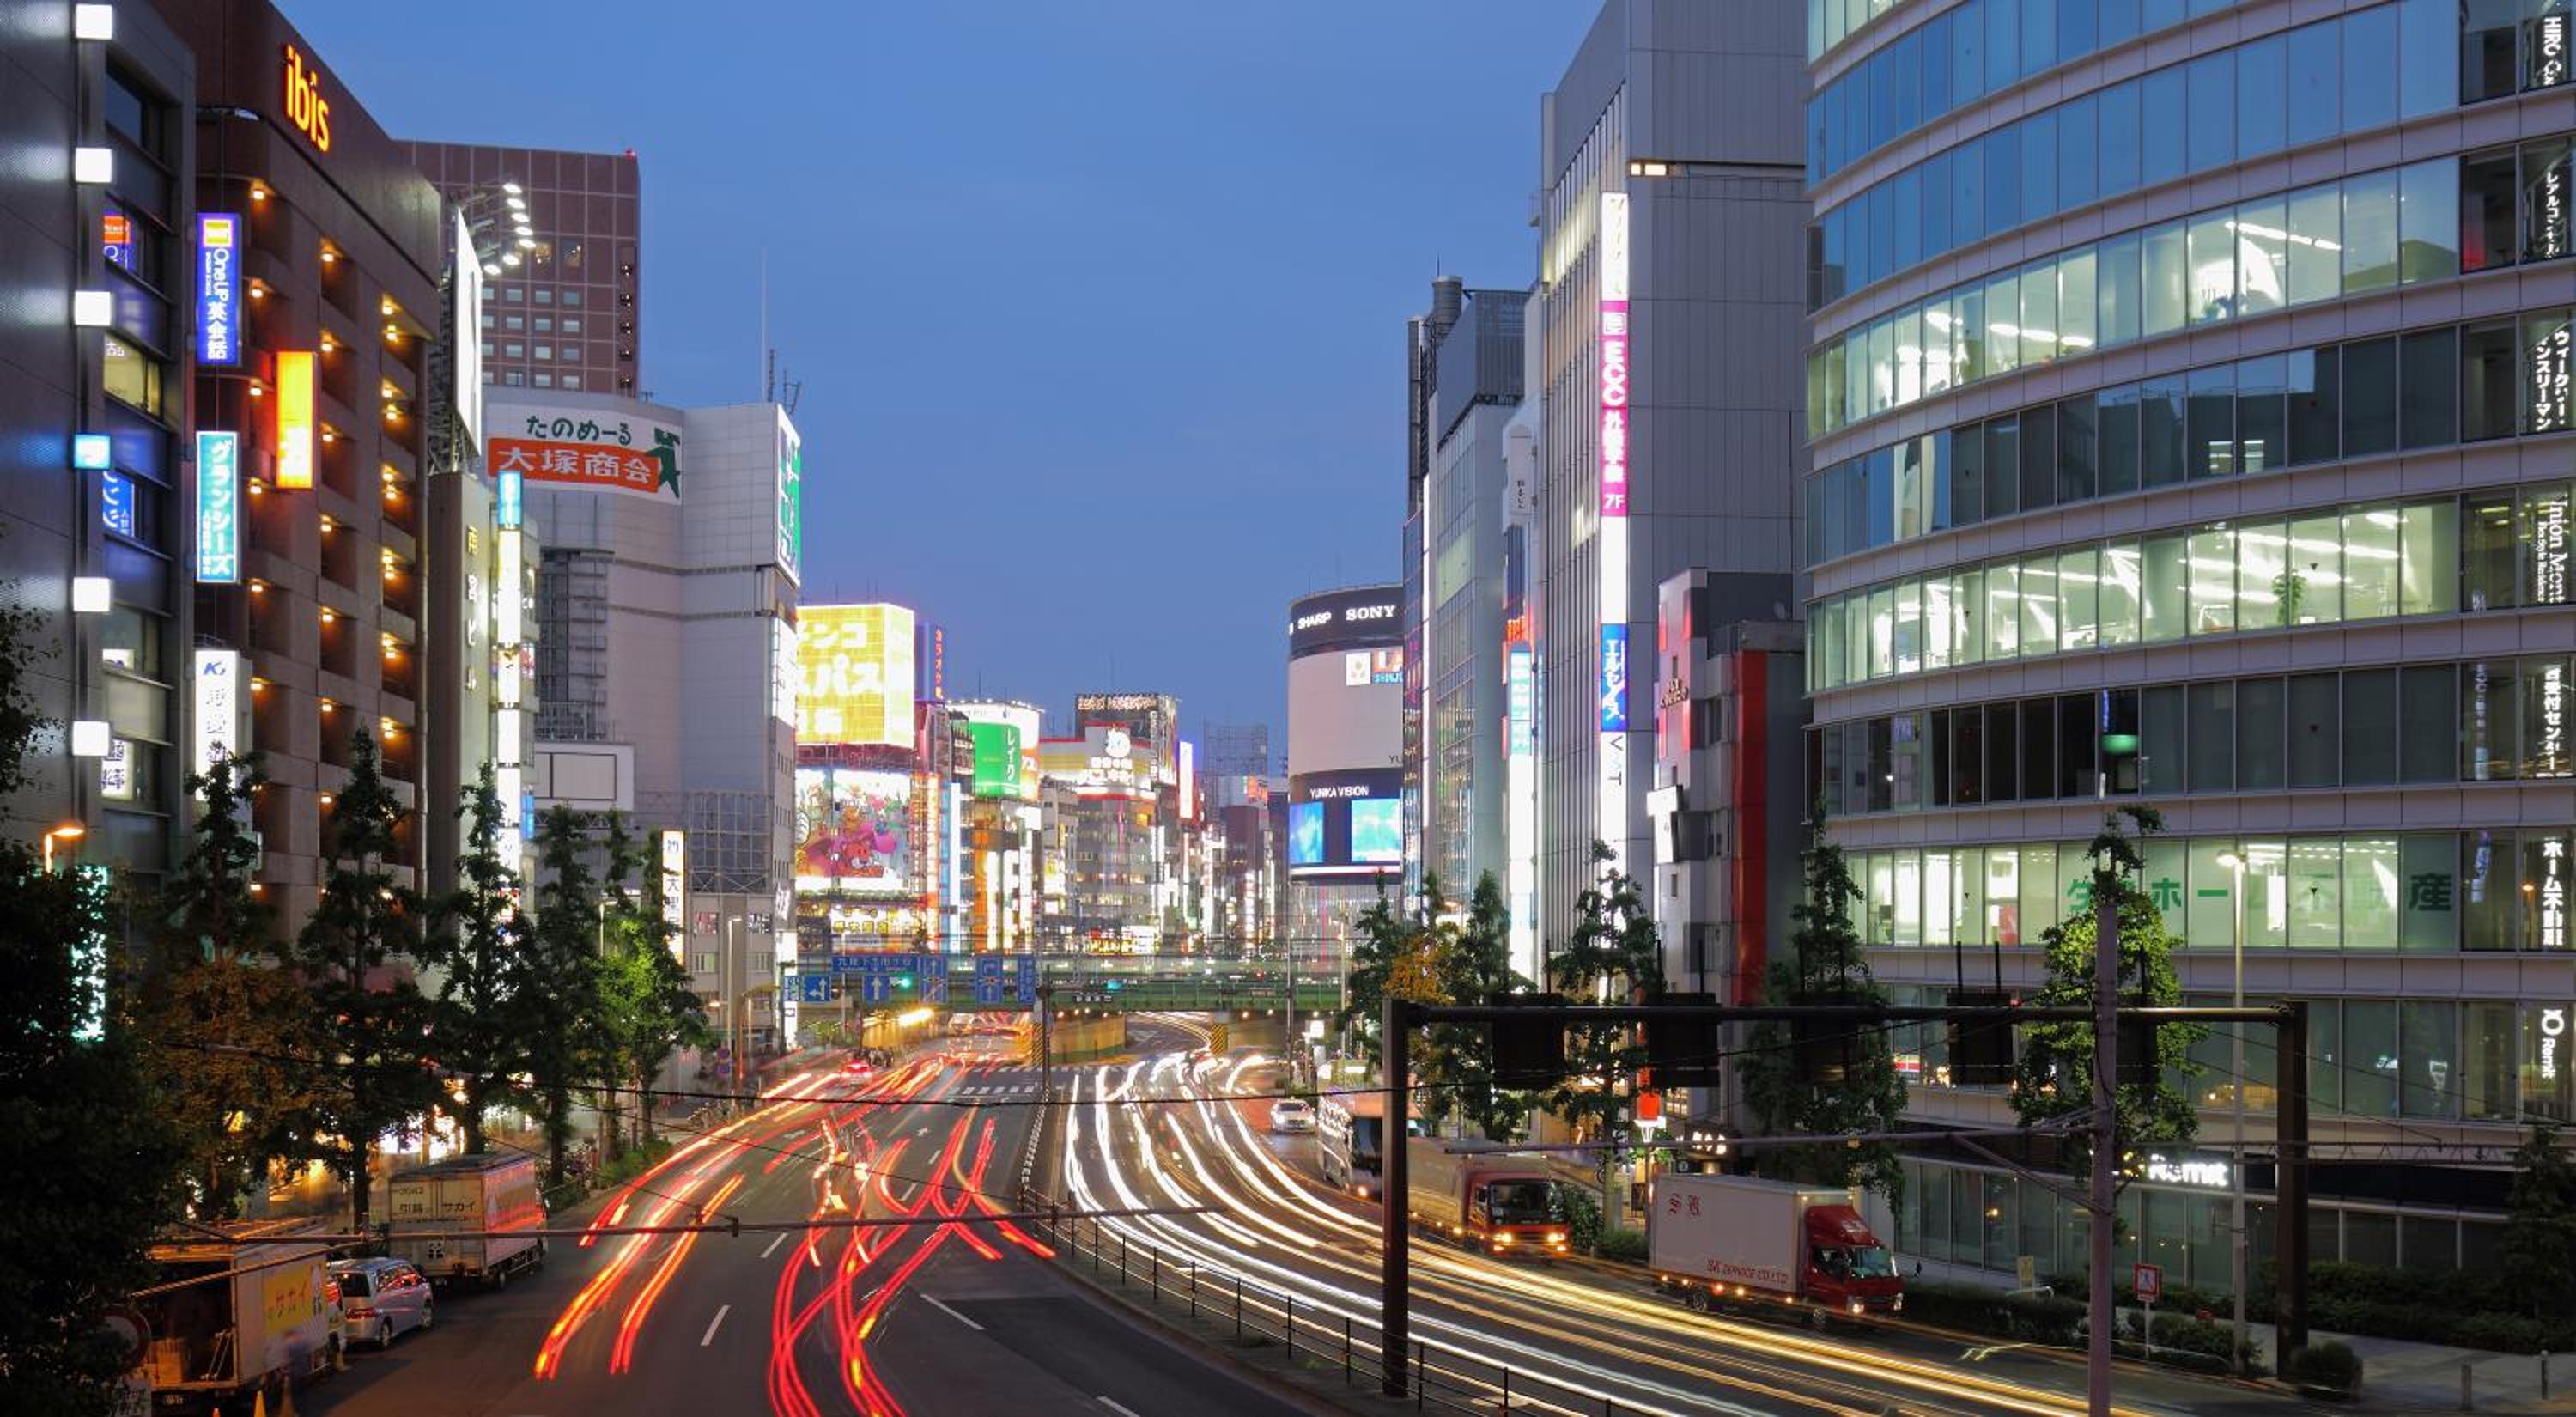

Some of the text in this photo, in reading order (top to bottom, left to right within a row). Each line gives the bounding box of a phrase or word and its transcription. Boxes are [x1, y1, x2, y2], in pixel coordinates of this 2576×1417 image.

[287, 44, 329, 152] ibis
[1602, 340, 1625, 406] ECC
[526, 415, 632, 445] たのめーる
[497, 447, 651, 483] 大塚商会
[1604, 493, 1625, 508] 7F
[1297, 611, 1332, 629] SHARP
[1346, 605, 1395, 621] SONY
[1337, 786, 1369, 797] VISION
